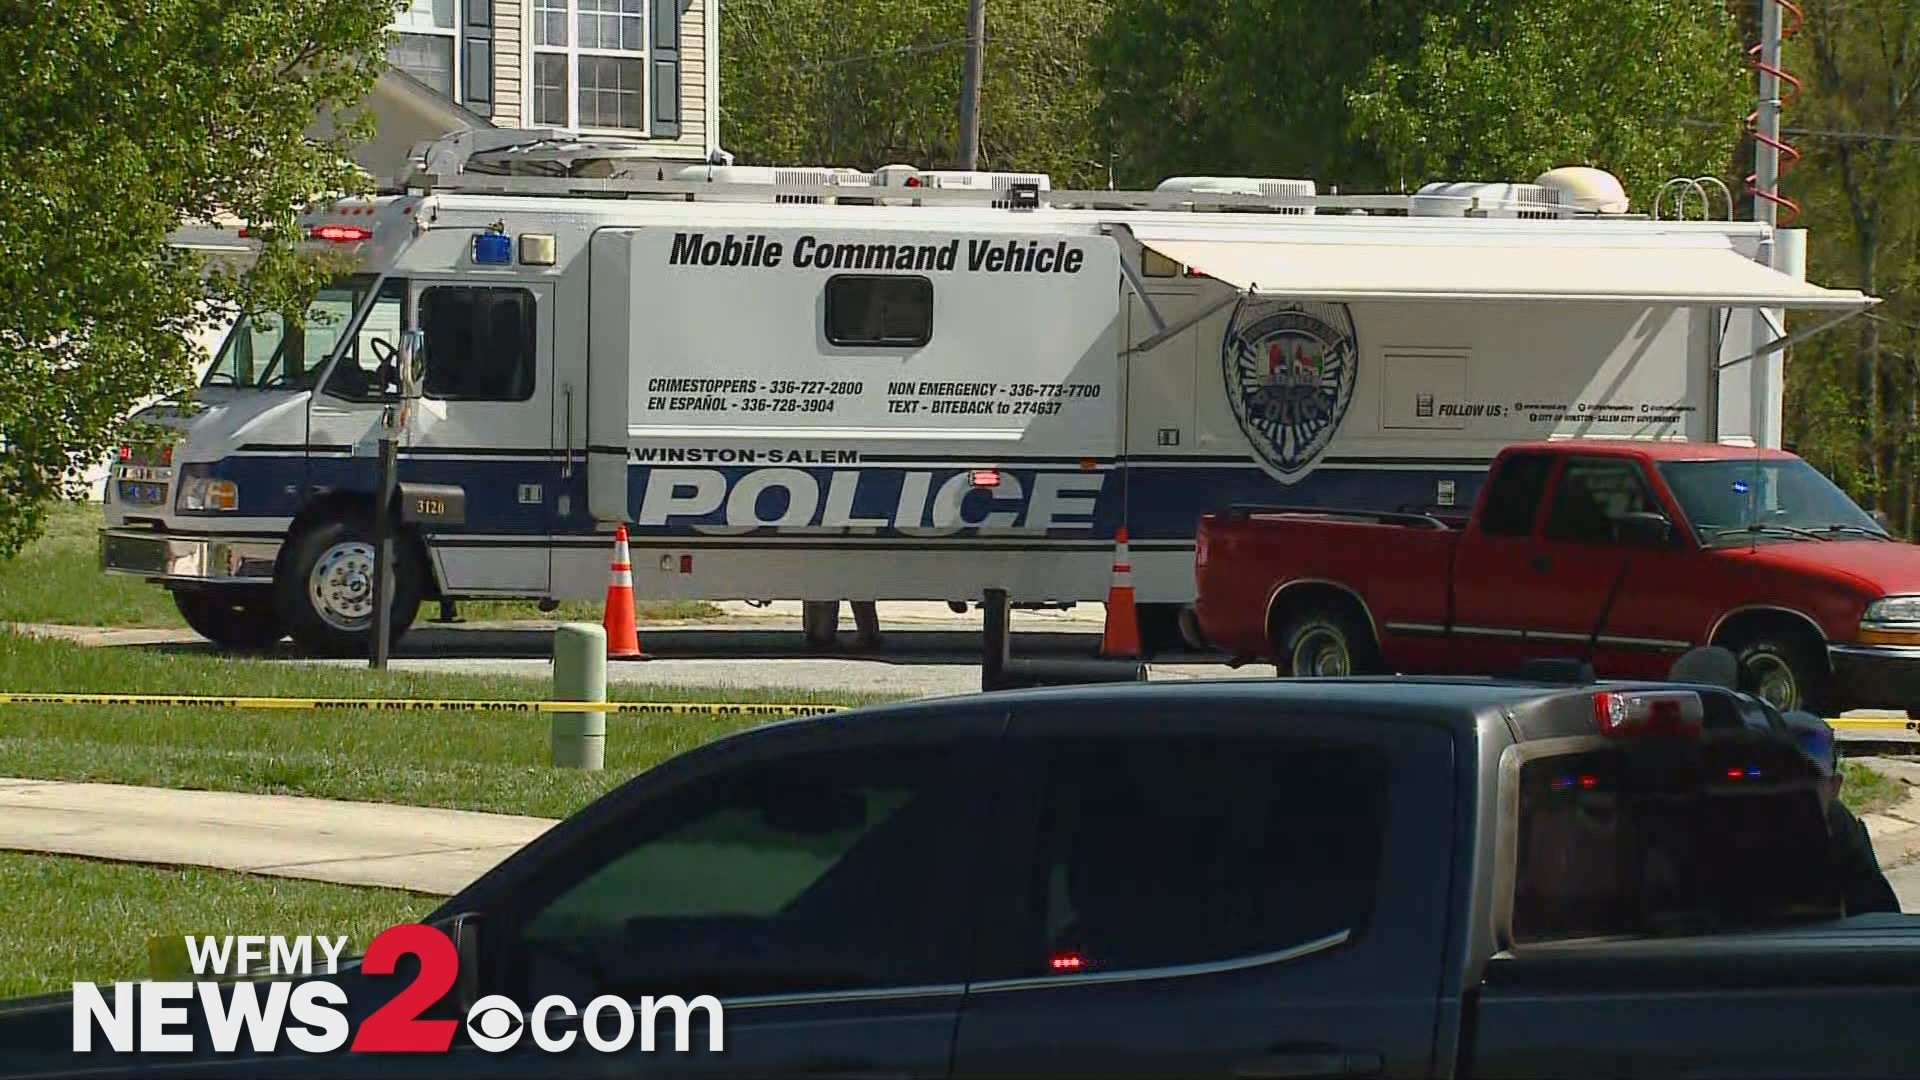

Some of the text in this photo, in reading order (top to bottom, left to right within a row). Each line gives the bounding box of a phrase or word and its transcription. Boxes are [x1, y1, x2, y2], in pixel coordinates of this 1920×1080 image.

[669, 232, 1083, 274] Mobile Command Vehicle
[648, 378, 757, 393] CRIMESTOPPERS
[769, 380, 863, 395] 336-727-2800
[887, 382, 916, 395] NON
[918, 382, 998, 396] EMERGENCY
[1009, 383, 1101, 398] 336-773-7700
[647, 396, 666, 410] EN
[669, 394, 728, 410] ESPAÑOL
[741, 398, 834, 412] 336-728-3904
[888, 400, 920, 413] TEXT
[931, 400, 994, 414] BITEBACK
[997, 401, 1010, 414] to
[1012, 401, 1063, 414] 274637
[1438, 404, 1484, 417] FOLLOW
[1486, 405, 1502, 417] US
[634, 448, 859, 464] WINSTON-SALEM
[639, 467, 1105, 537] POLICE
